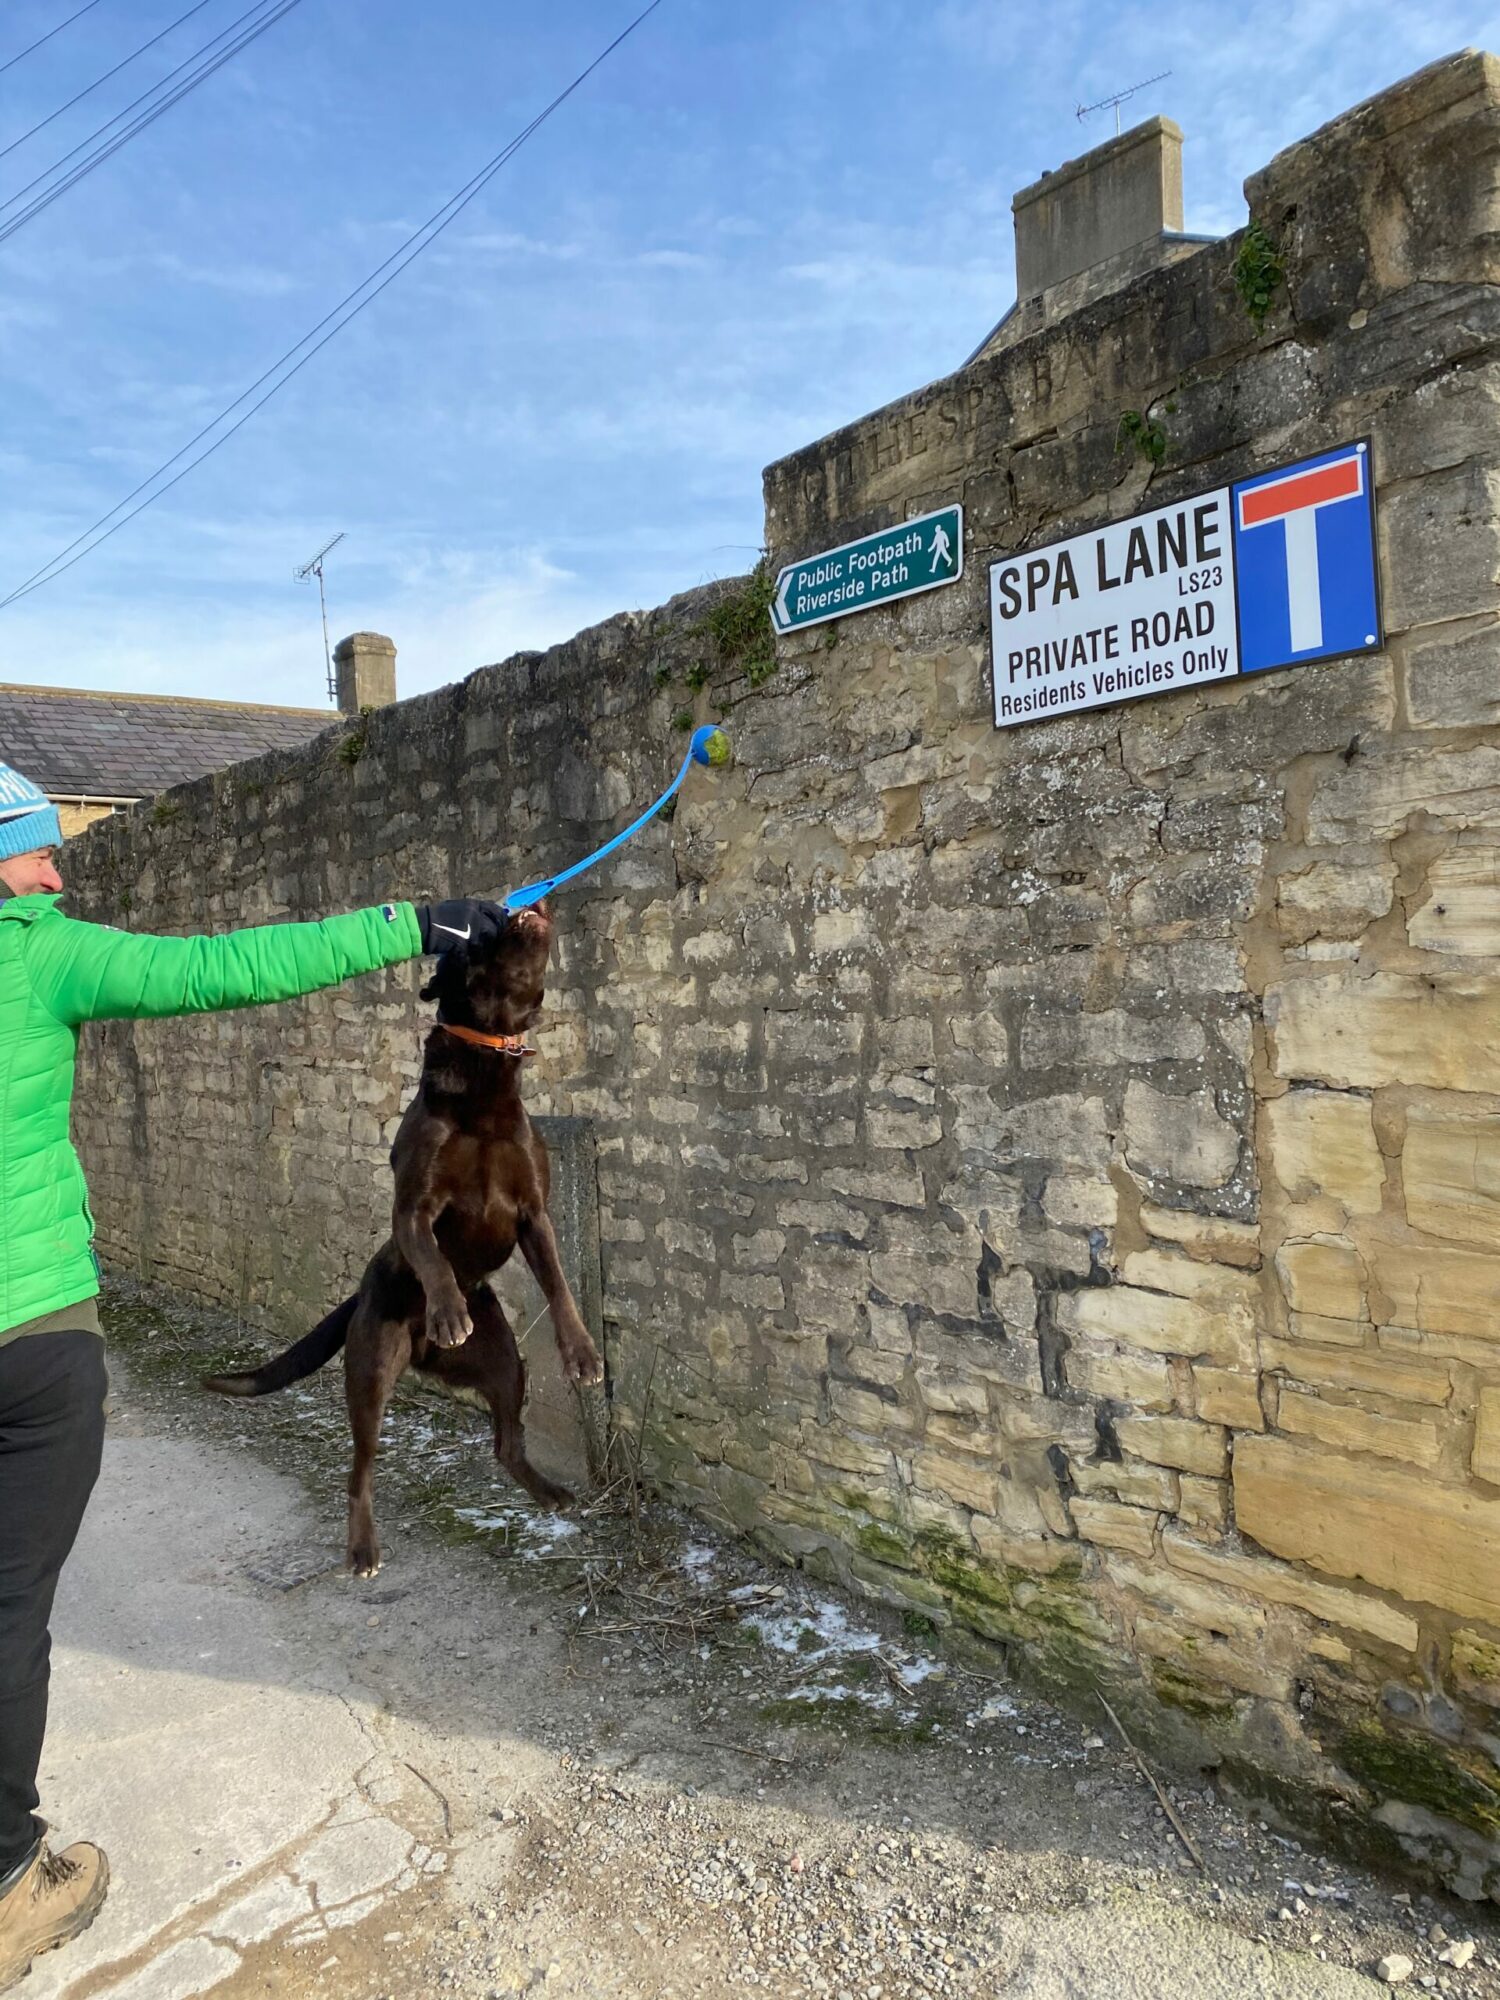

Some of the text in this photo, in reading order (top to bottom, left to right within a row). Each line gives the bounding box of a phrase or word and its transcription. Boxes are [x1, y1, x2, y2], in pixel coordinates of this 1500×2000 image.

[796, 563, 908, 616] Riverside Path
[798, 532, 922, 591] Public Footpath
[999, 500, 1222, 620] SPA LANE
[1178, 566, 1223, 597] LS23
[1008, 600, 1215, 684] PRIVATE ROAD
[1001, 645, 1229, 717] Residents Vehicles Only
